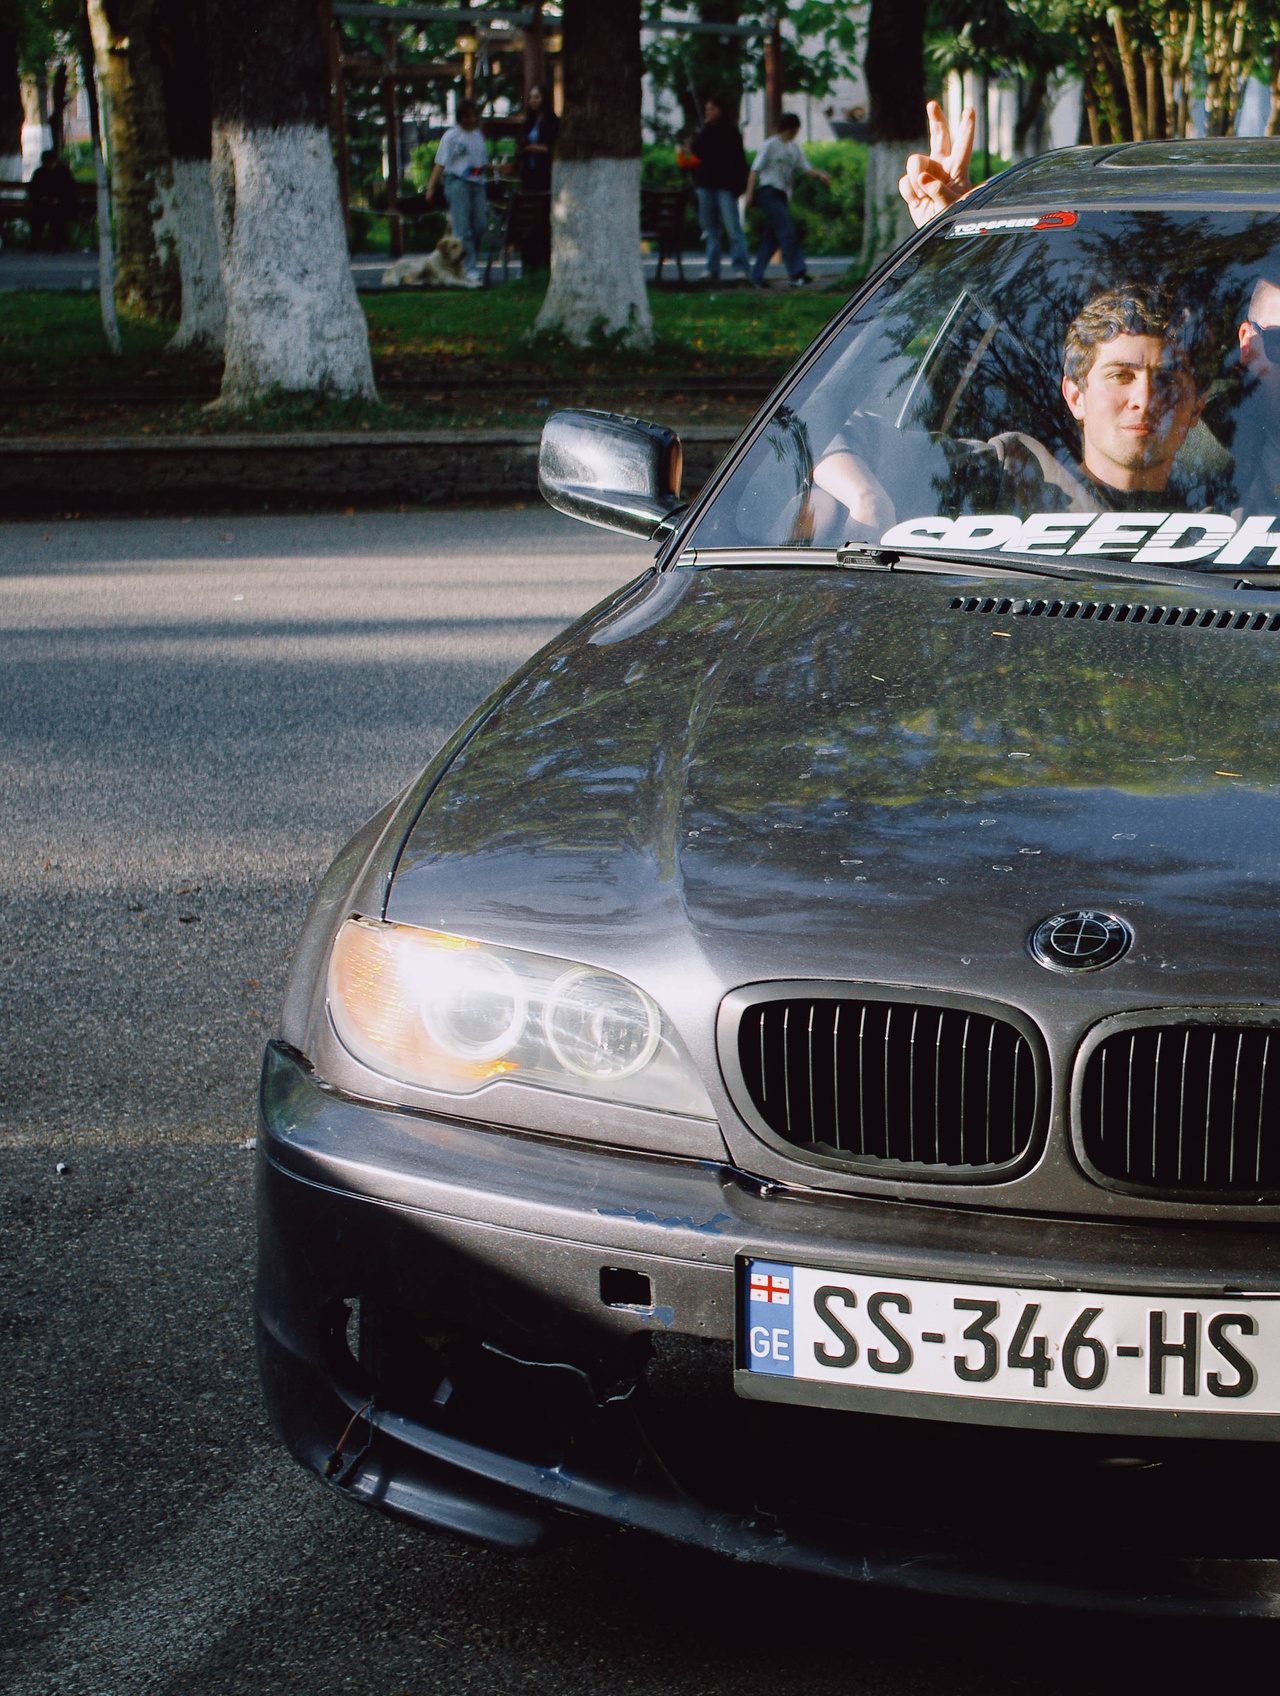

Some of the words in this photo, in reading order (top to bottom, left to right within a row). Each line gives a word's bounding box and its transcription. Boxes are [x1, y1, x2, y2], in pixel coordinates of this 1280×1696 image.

[1048, 911, 1120, 930] BMW
[749, 1326, 790, 1362] GE
[813, 1285, 1258, 1398] SS-346-HS
